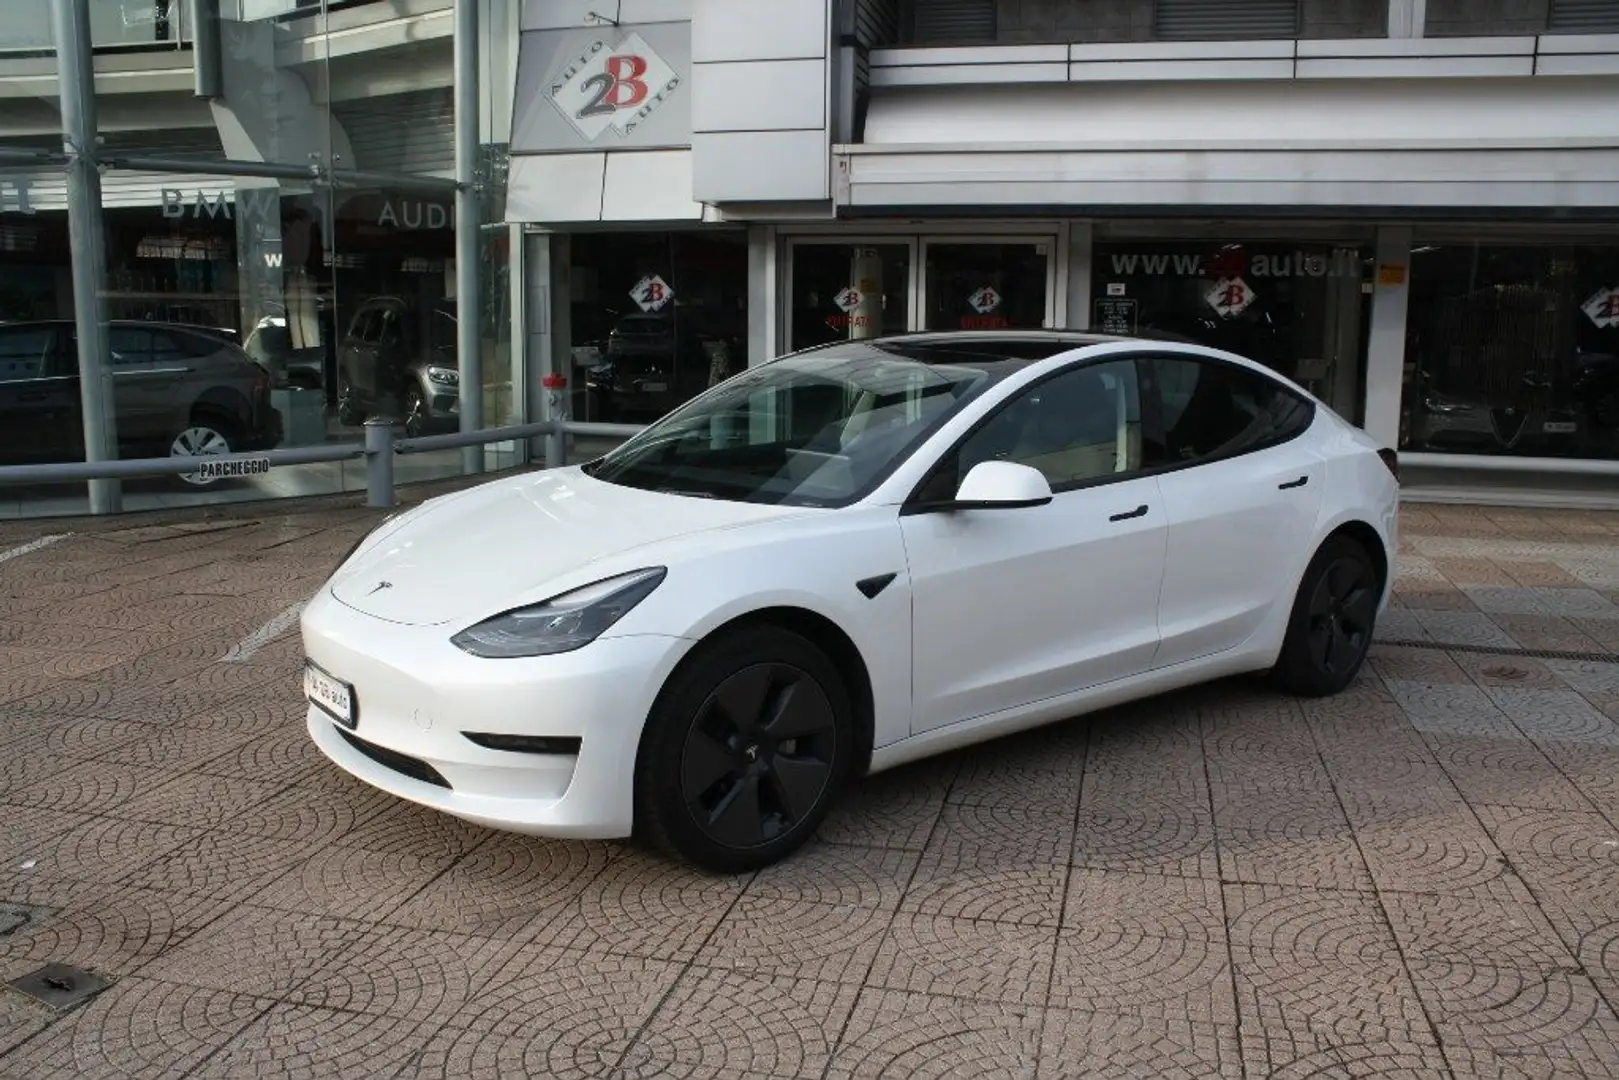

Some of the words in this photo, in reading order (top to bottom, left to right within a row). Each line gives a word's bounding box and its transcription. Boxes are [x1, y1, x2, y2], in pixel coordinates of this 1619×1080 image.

[576, 54, 648, 119] 2B
[162, 187, 275, 219] BMW
[378, 200, 456, 231] AUDI
[200, 459, 269, 477] PARCHEGGIO
